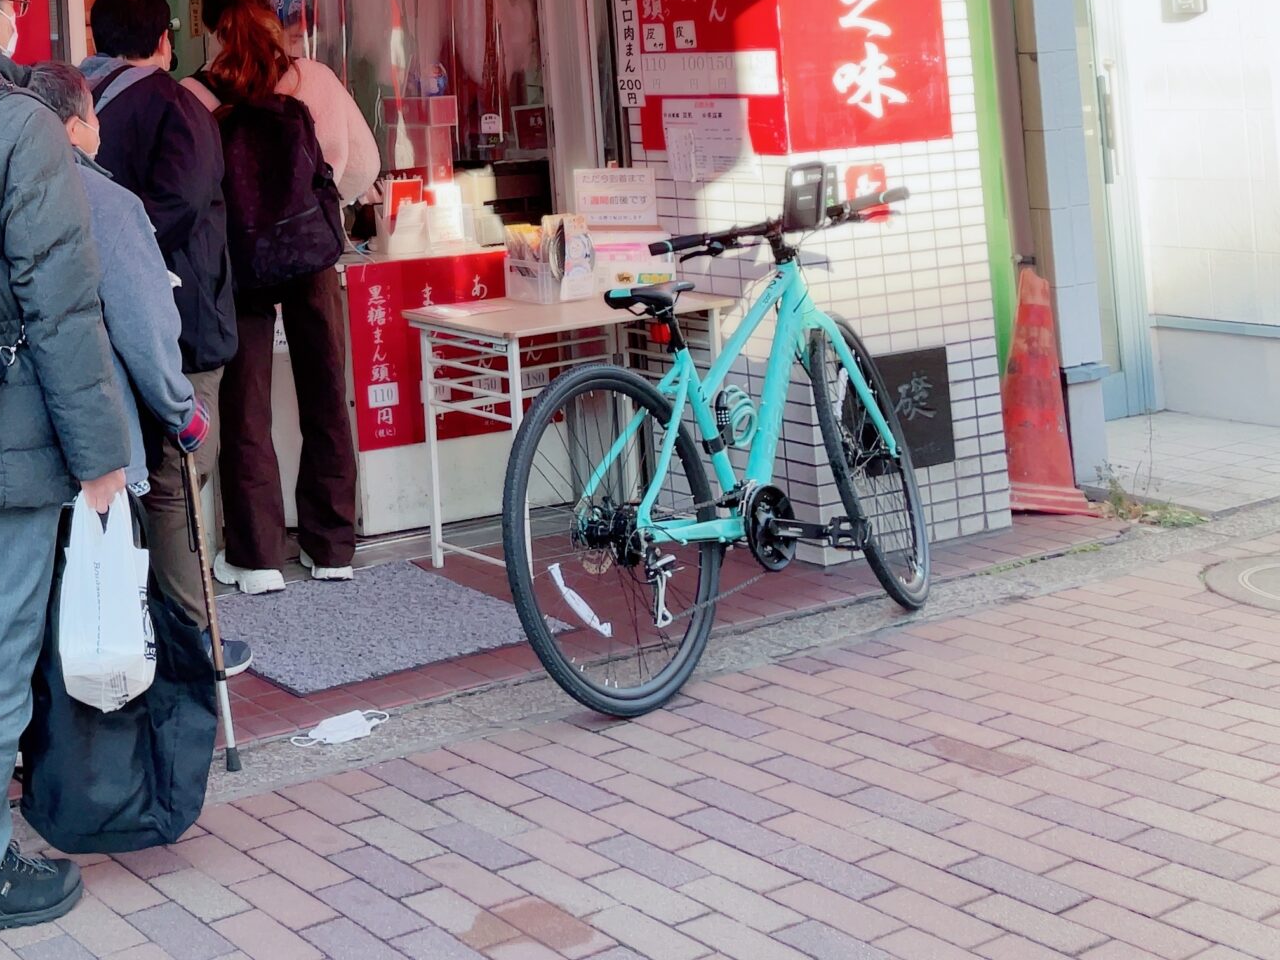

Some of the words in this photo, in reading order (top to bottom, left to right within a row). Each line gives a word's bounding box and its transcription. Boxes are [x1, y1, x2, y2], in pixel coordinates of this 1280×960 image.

[620, 79, 641, 90] 200
[627, 93, 637, 104] 円
[373, 390, 394, 403] 110
[377, 408, 393, 425] 円
